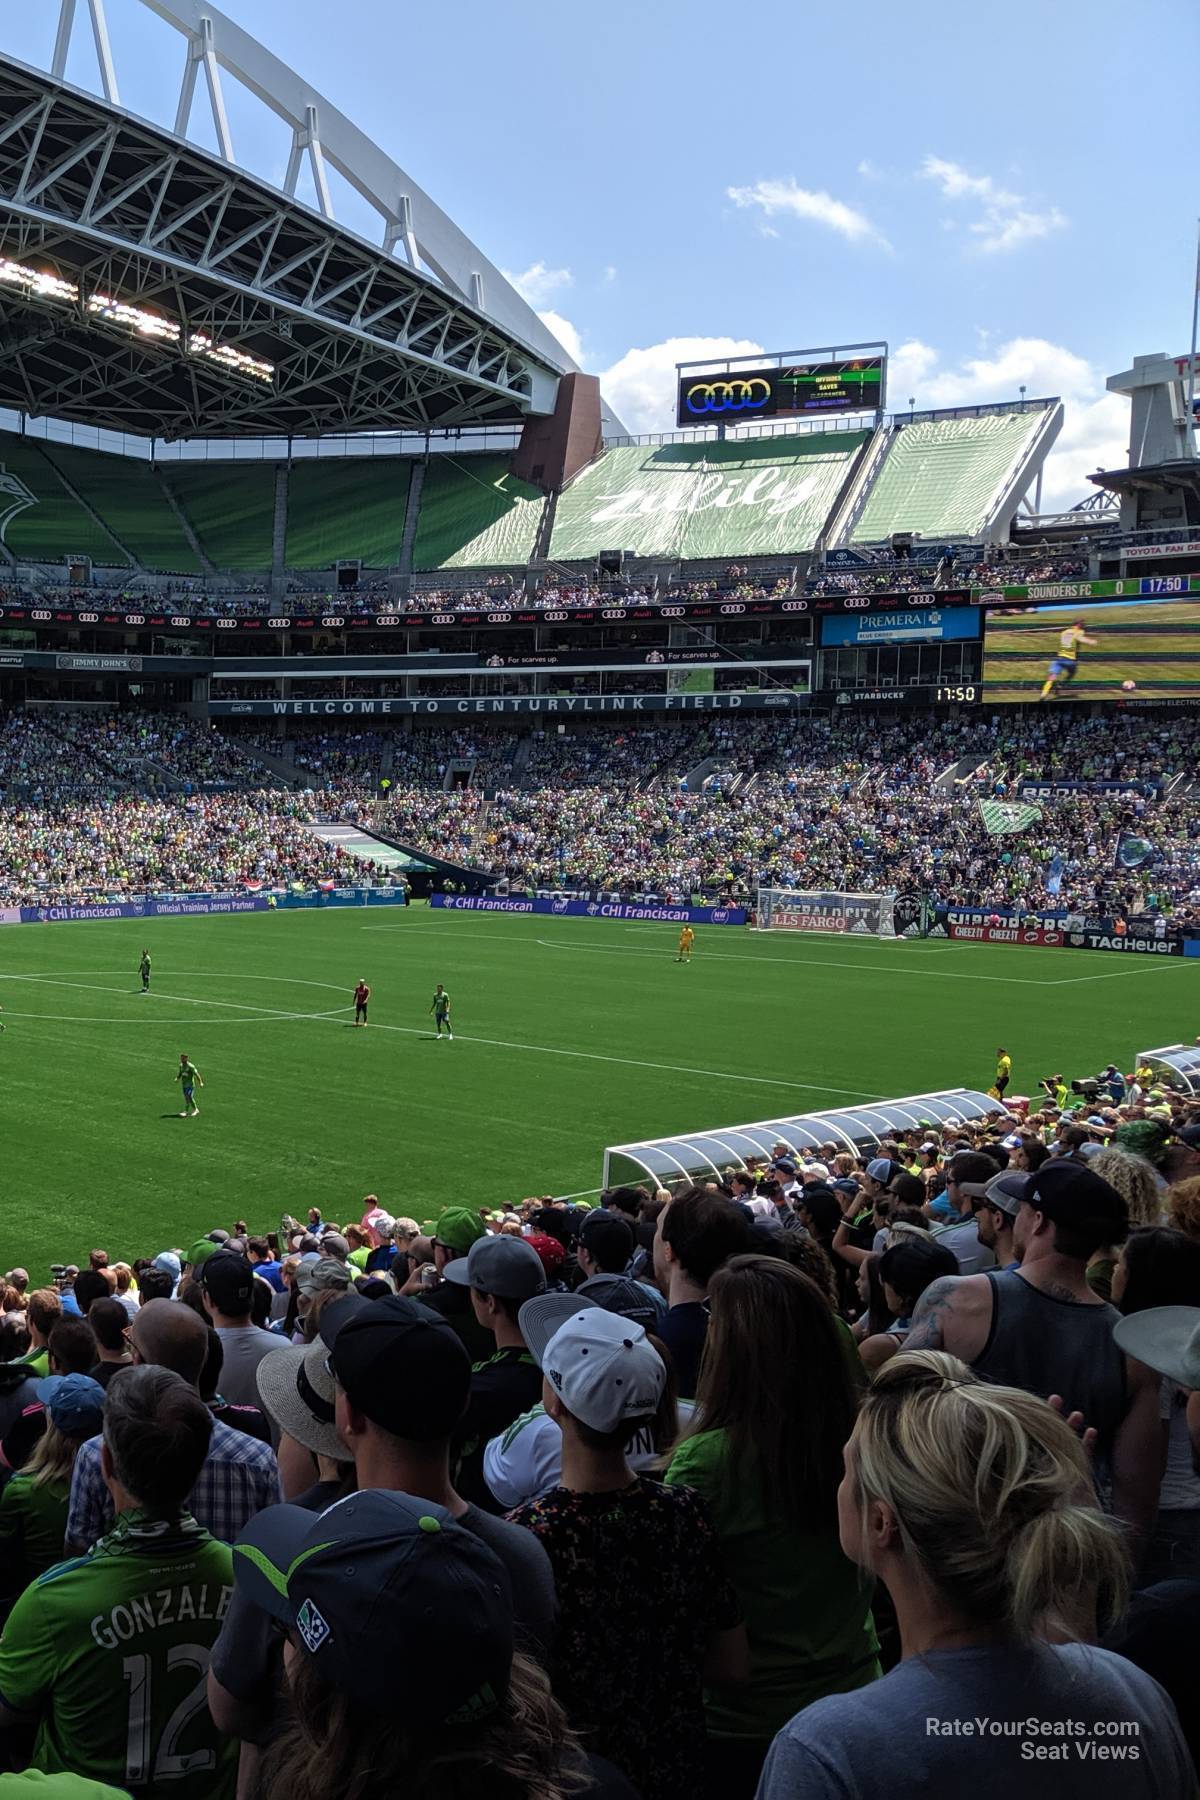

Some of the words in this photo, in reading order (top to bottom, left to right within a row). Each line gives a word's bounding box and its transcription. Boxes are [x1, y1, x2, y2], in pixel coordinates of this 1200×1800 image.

[1125, 547, 1161, 556] TOYOTA
[1165, 545, 1184, 553] FAN
[1027, 584, 1077, 599] SOUNDERS
[1080, 584, 1092, 596] FC
[1116, 581, 1123, 594] 0
[1150, 577, 1182, 592] 17:50
[859, 614, 921, 629] PREMERA
[508, 656, 519, 664] For
[520, 657, 546, 665] scarves
[548, 656, 559, 665] up.
[668, 652, 681, 660] For
[682, 652, 708, 660] scarves
[710, 650, 721, 660] up.
[72, 659, 99, 667] JIMMY
[101, 659, 127, 667] JOHN'S
[854, 692, 906, 700] STARBUCKS
[938, 687, 975, 701] 17:50
[273, 702, 392, 714] WELCOME
[410, 701, 438, 712] TO
[458, 697, 644, 712] CENTURYLINK
[665, 696, 742, 710] FIELD
[157, 903, 180, 913] Official
[182, 902, 208, 913] Training
[210, 901, 230, 912] Jersey
[231, 901, 255, 910] Partner
[455, 896, 474, 909] CHI
[476, 898, 533, 912] Franciscan
[50, 908, 68, 919] CHI
[70, 905, 122, 918] Franciscan
[601, 904, 623, 917] CHI
[625, 905, 690, 921] Franciscan
[800, 913, 846, 929] FARGO
[123, 1643, 216, 1785] 12
